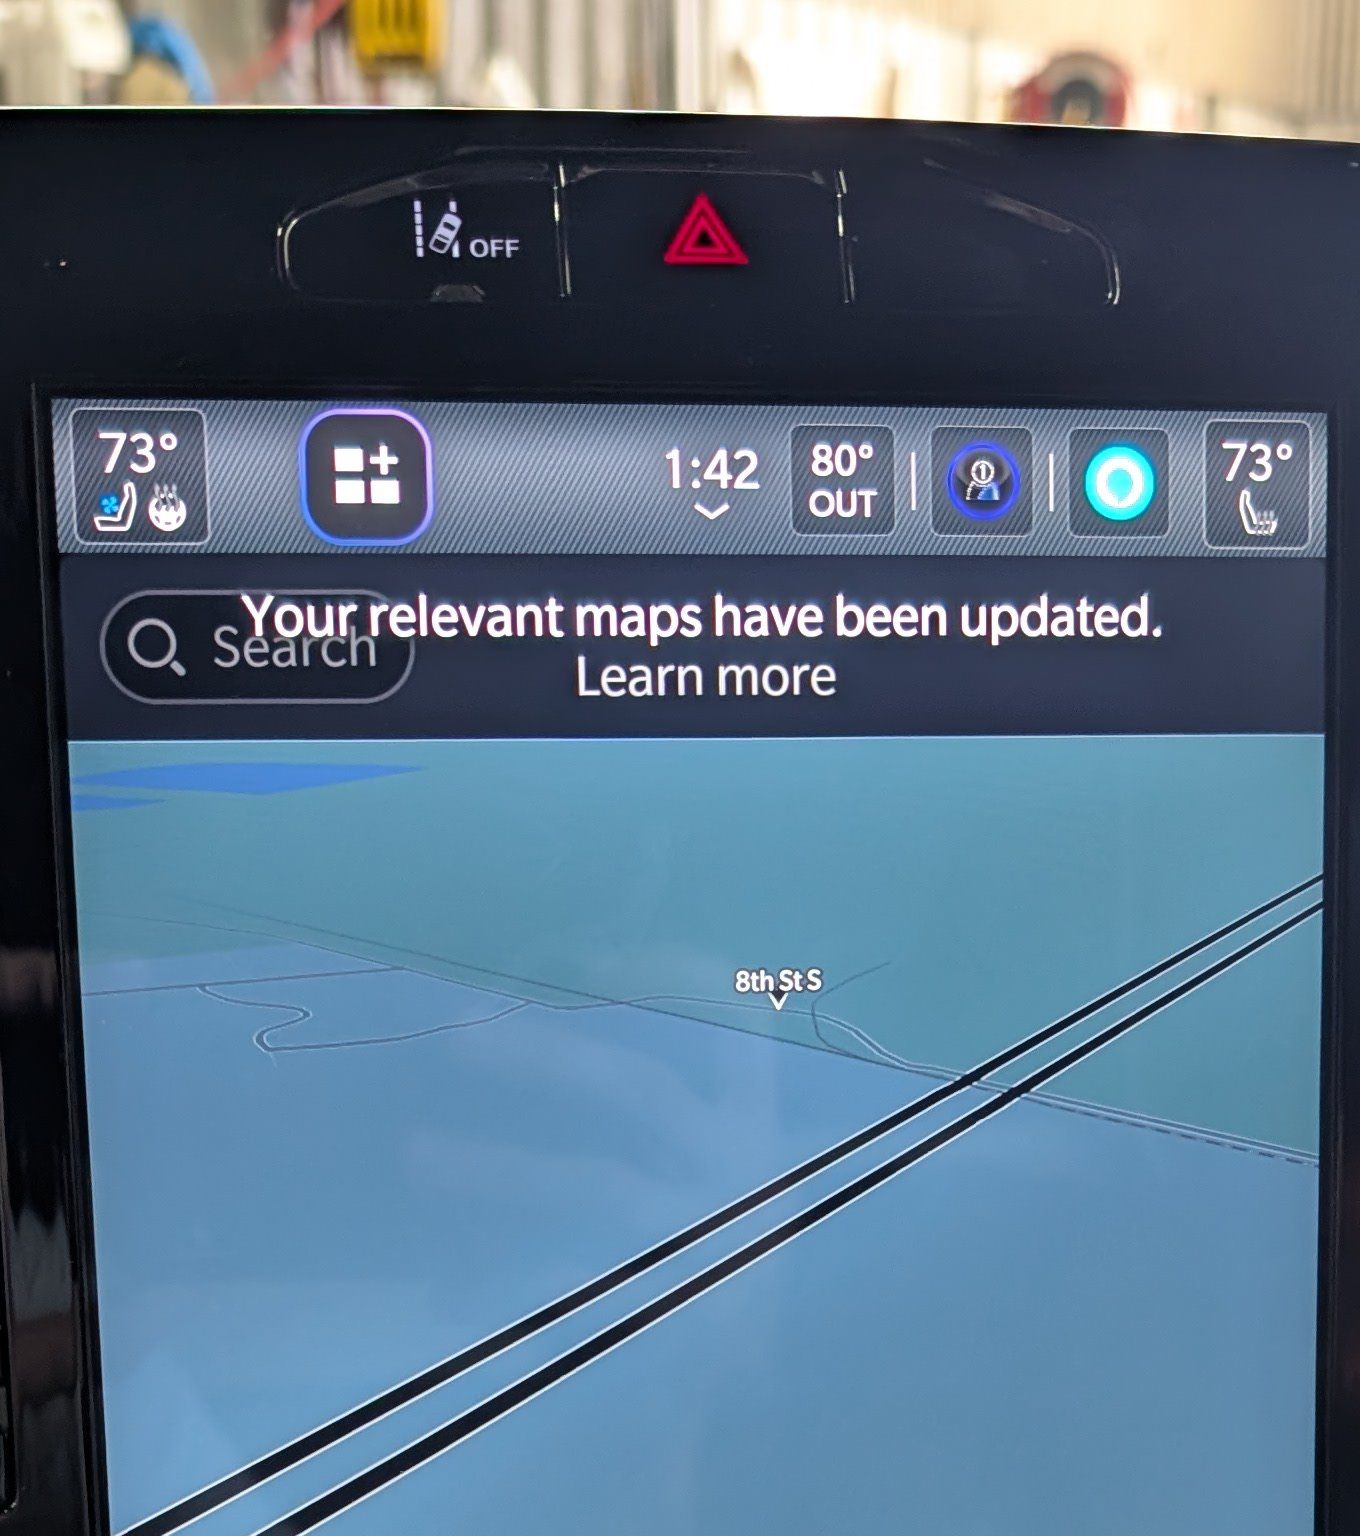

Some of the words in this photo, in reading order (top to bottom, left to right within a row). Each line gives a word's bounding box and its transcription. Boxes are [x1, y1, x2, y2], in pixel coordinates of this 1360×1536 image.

[469, 238, 519, 258] OFF
[98, 432, 178, 474] 73°
[665, 445, 761, 490] 1:42
[811, 441, 874, 477] 80°
[1221, 440, 1293, 482] 73°
[808, 487, 879, 518] OUT
[241, 593, 359, 638] Your
[370, 592, 565, 638] relevant
[575, 602, 703, 646] maps
[714, 592, 824, 638] have
[835, 592, 947, 638] been
[961, 592, 1162, 646] updated.
[212, 626, 378, 668] Search
[577, 655, 703, 697] Learn
[718, 664, 836, 697] more
[734, 968, 775, 993] 8th
[778, 968, 804, 993] St
[806, 968, 823, 992] S
